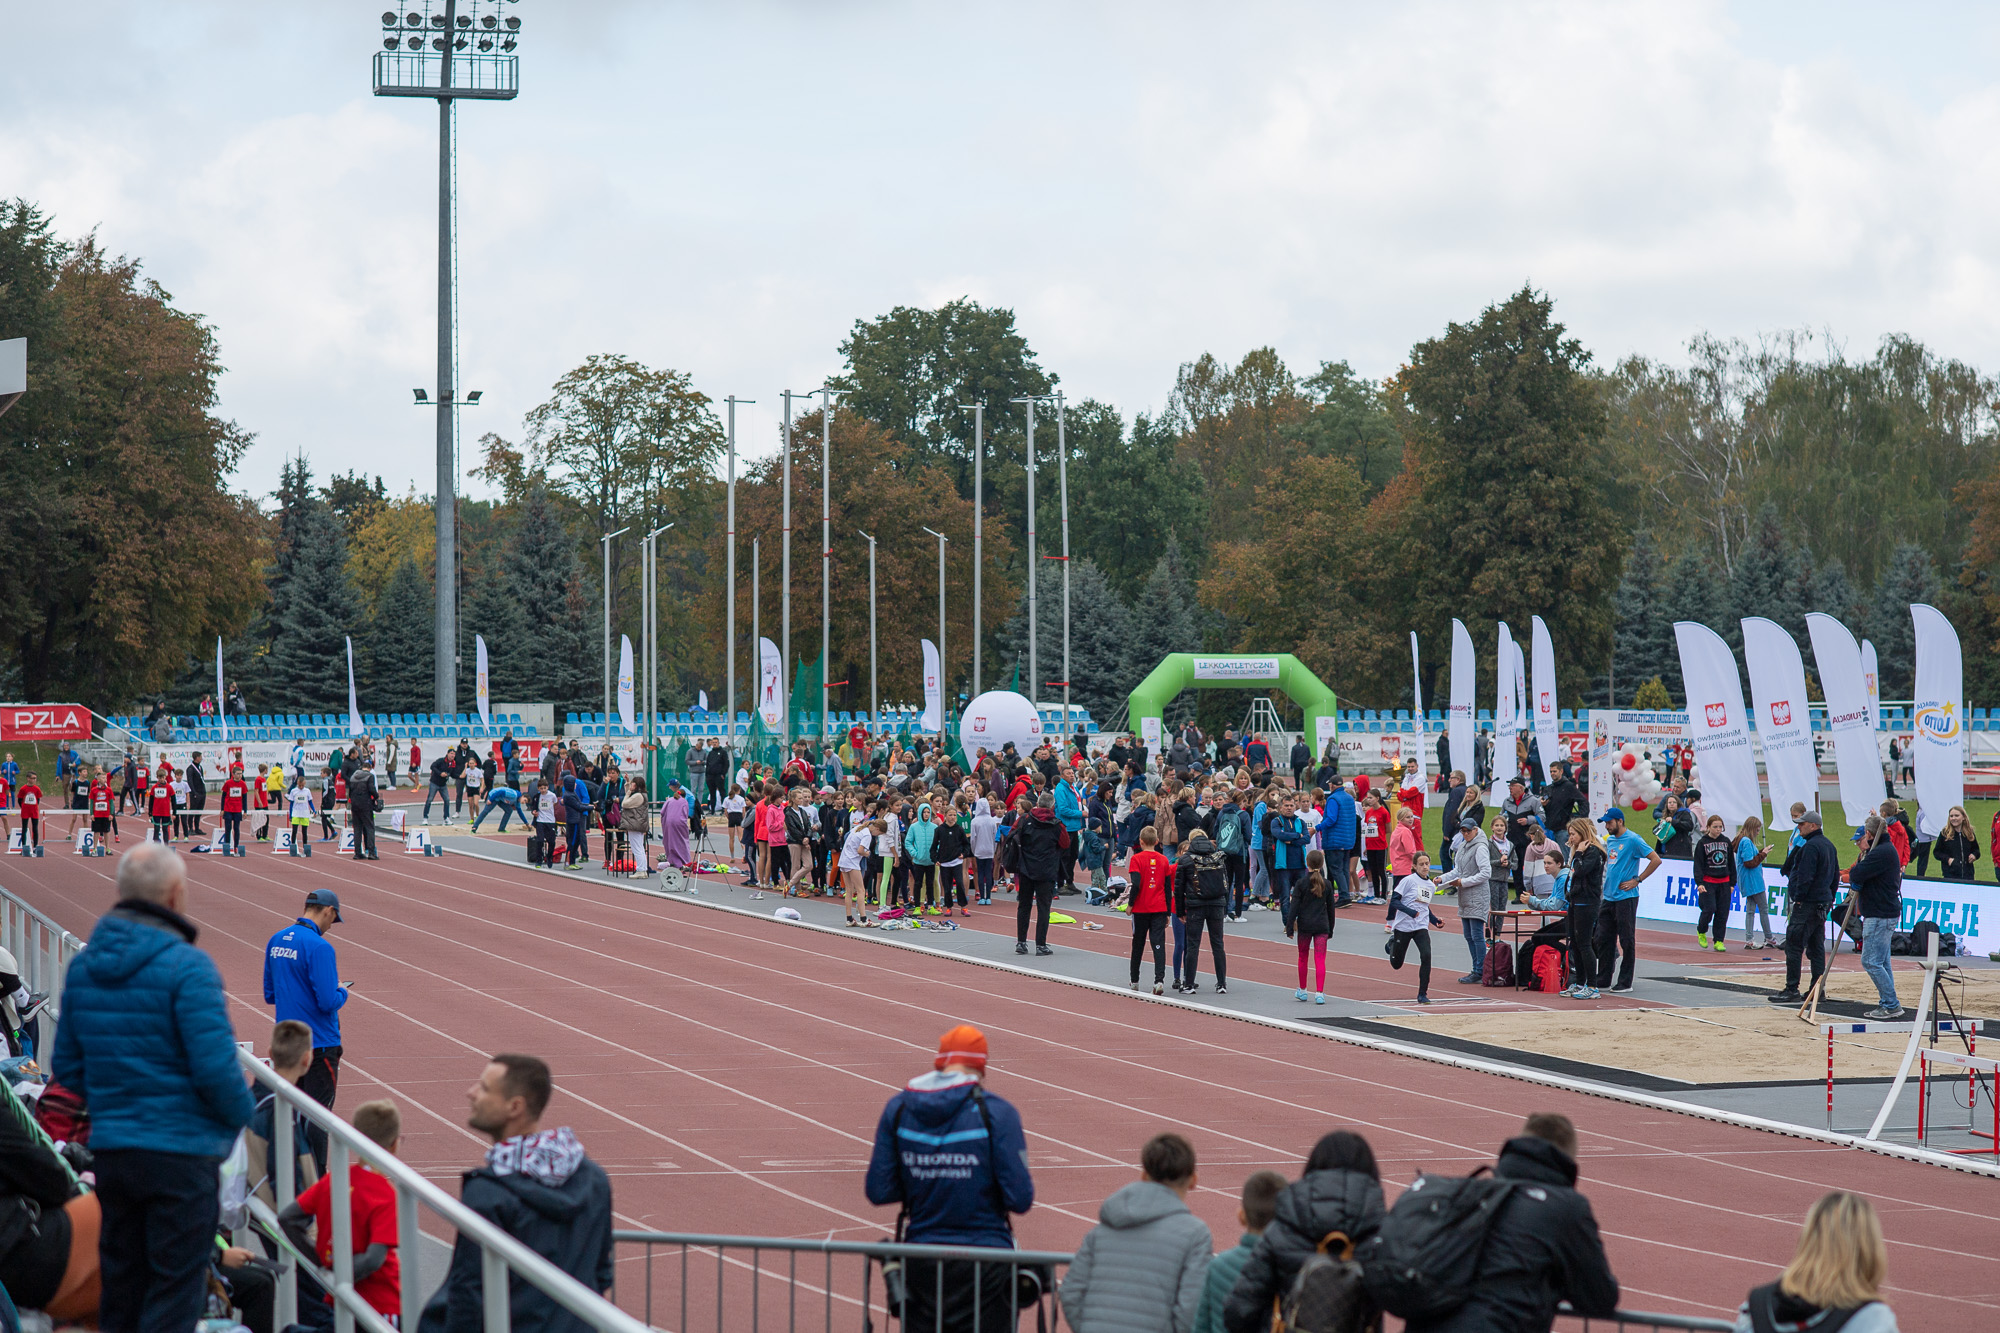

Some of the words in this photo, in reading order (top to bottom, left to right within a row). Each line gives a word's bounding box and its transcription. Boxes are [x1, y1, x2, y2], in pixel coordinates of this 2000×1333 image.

[15, 711, 79, 729] PZLA
[1339, 742, 1363, 751] ACJA
[1220, 822, 1233, 840] NIKE
[16, 832, 23, 847] 7
[84, 832, 94, 847] 6
[218, 833, 226, 846] 4
[282, 833, 291, 847] 3
[347, 833, 355, 847] 2
[416, 833, 423, 847] 1
[270, 946, 298, 960] SĘDZIA
[917, 1152, 980, 1166] HONDA
